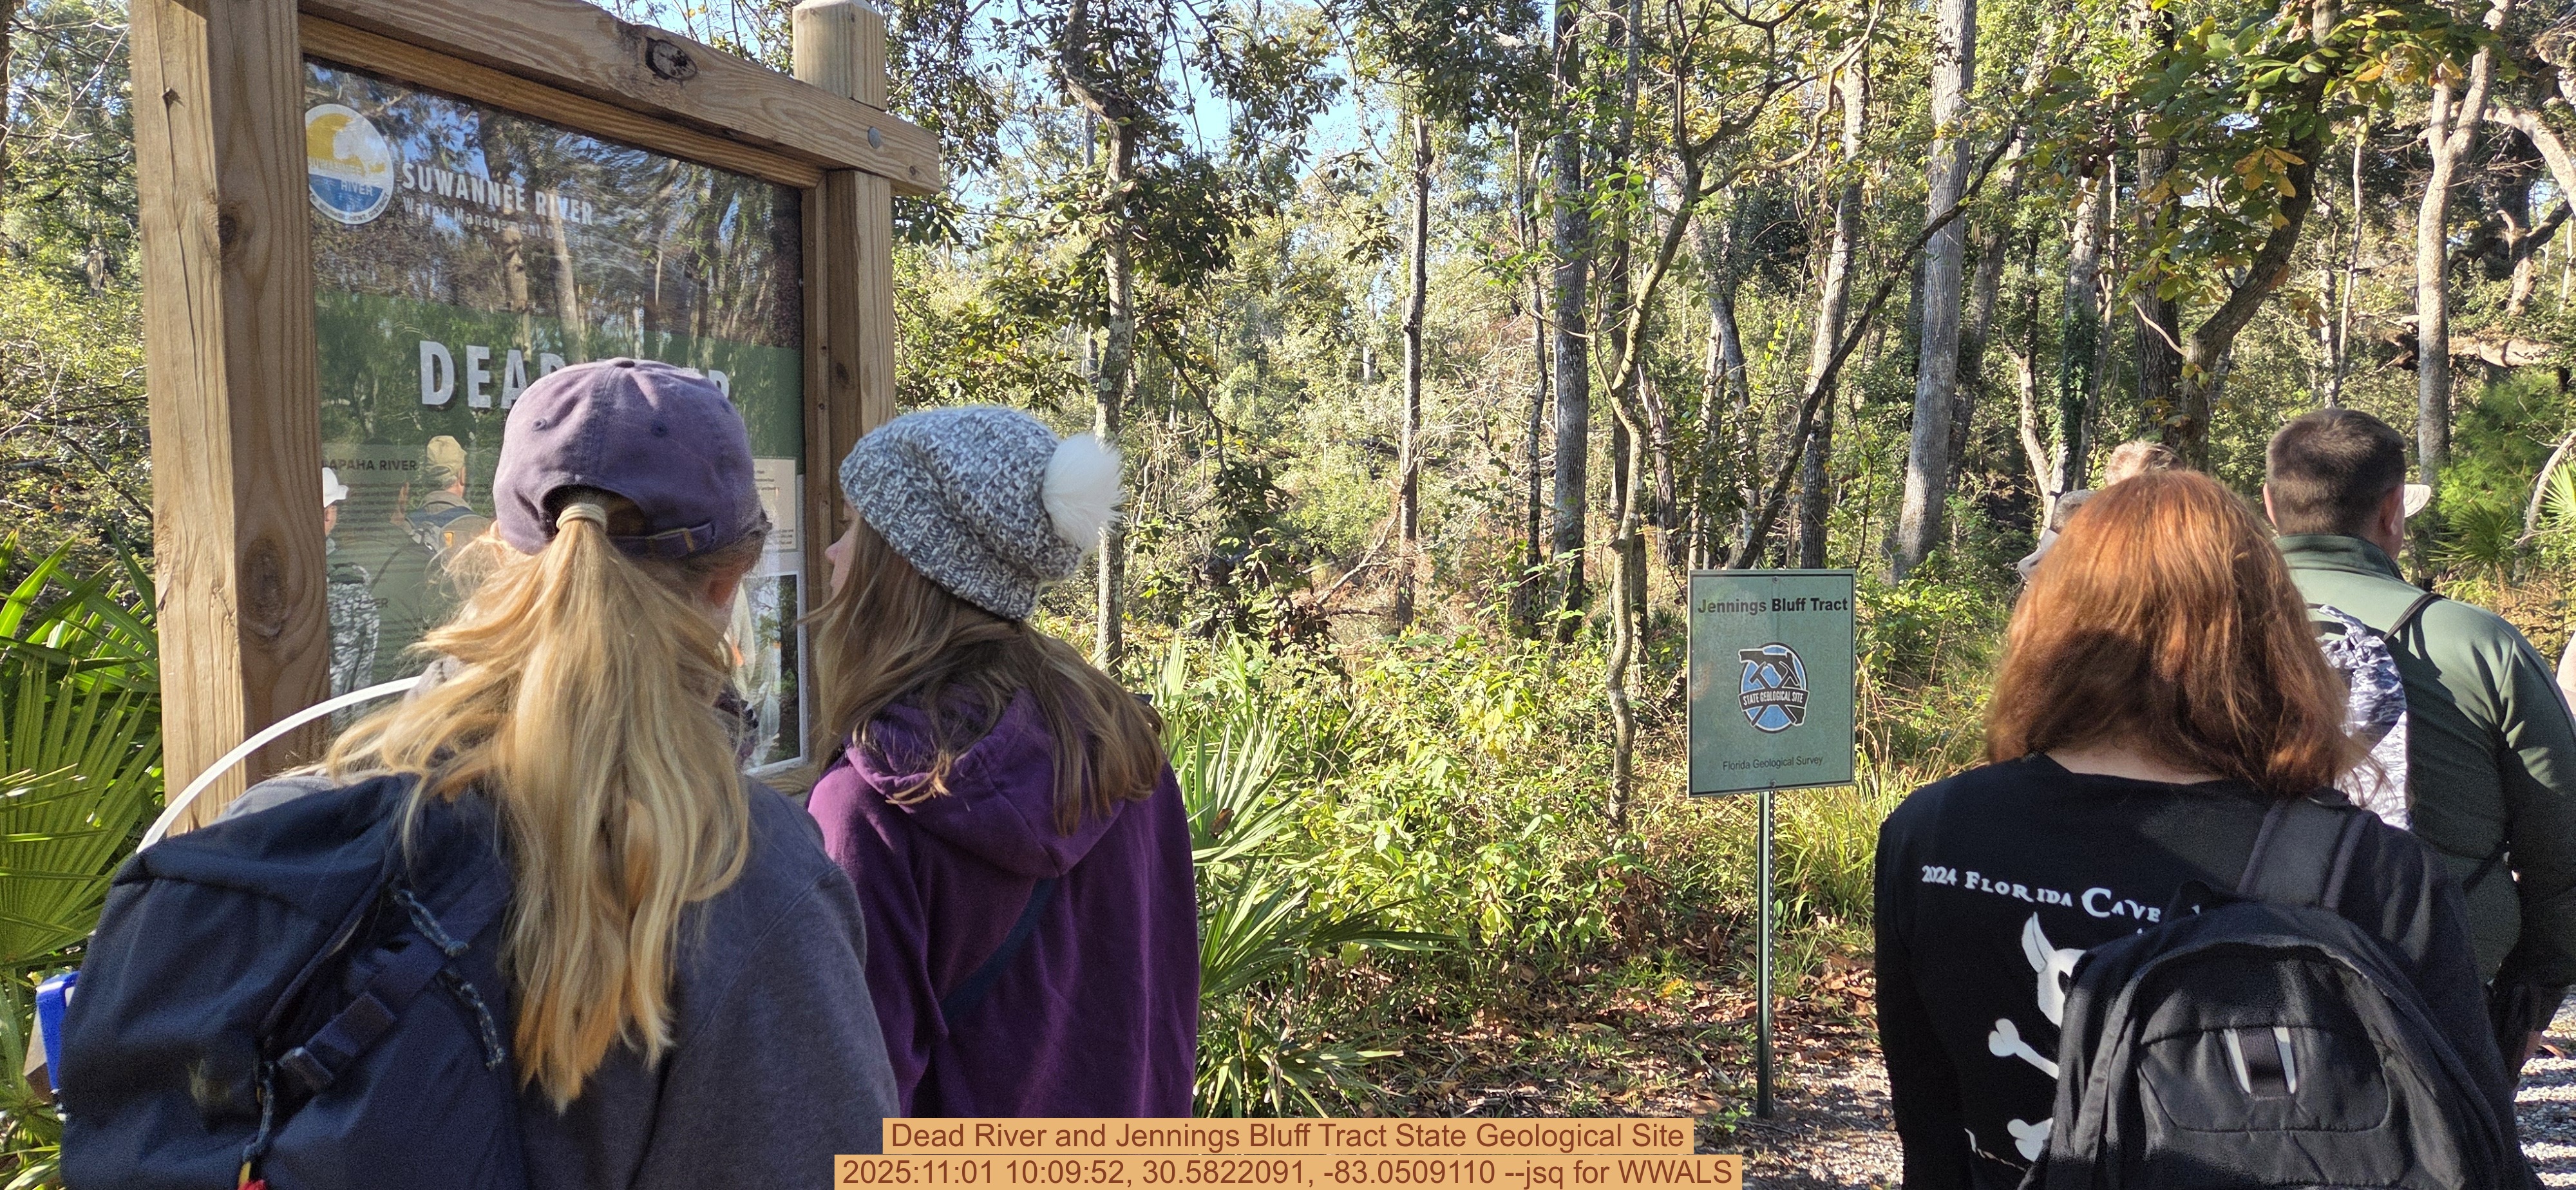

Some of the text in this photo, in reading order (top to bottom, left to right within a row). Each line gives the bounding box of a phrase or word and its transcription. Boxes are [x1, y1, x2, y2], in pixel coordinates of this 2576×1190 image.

[341, 180, 373, 196] RIVER
[402, 162, 526, 212] SUWANNEE
[535, 189, 593, 226] RIVER
[402, 195, 446, 218] Water
[379, 459, 418, 471] RIVER
[1698, 597, 1848, 616] Jennings Bluff Tract
[1743, 690, 1804, 706] STATE GEOLOGICAL SITE
[1723, 755, 1823, 771] Florida Geological Survey
[1921, 865, 1958, 886] 2024
[1964, 870, 2073, 907] FLORIDA
